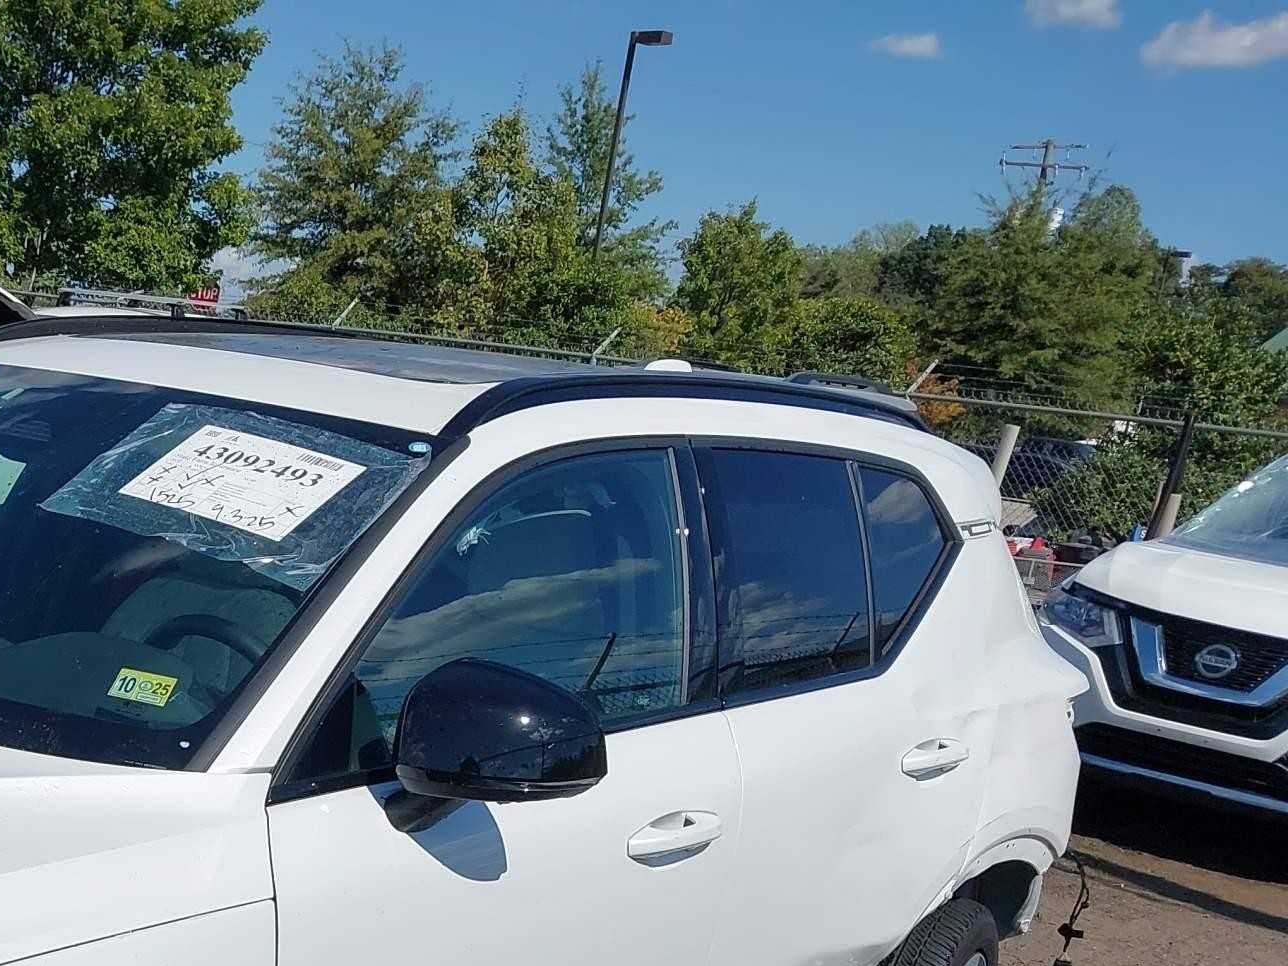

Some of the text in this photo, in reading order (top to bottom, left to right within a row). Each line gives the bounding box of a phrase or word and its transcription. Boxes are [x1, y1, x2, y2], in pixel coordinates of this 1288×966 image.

[193, 444, 324, 487] 43092493
[118, 676, 172, 697] 10 25
